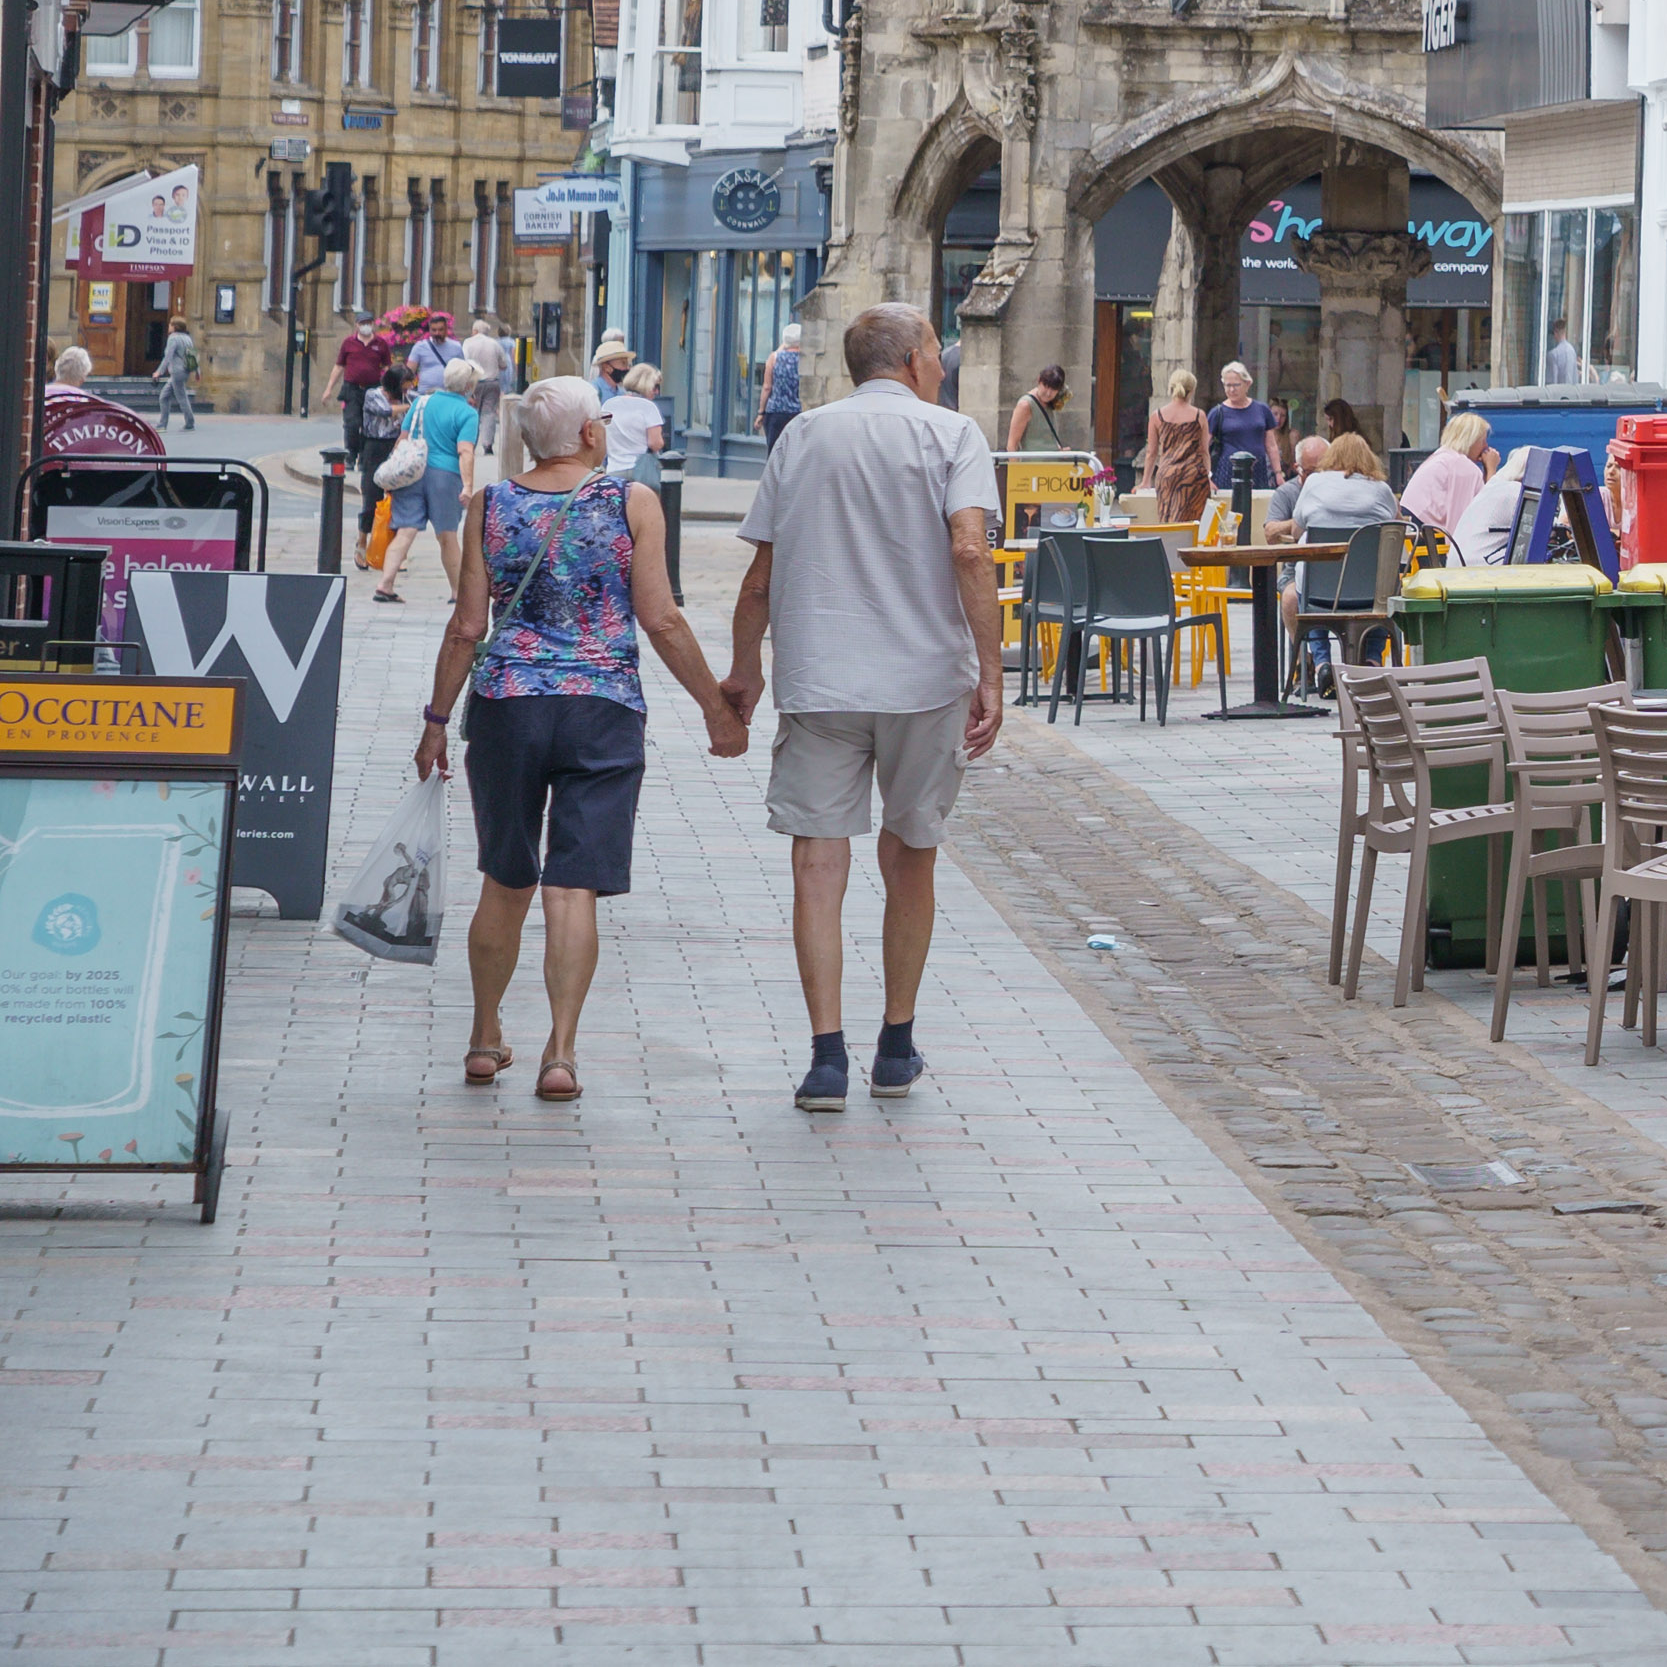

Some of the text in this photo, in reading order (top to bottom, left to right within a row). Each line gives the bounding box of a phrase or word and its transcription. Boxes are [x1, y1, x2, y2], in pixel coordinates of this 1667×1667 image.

[717, 169, 778, 197] SEASALT
[545, 189, 566, 203] JoJo
[146, 224, 190, 236] Passport
[525, 222, 560, 231] BAKERY
[149, 247, 184, 256] Photos
[129, 264, 166, 272] TIMPSON
[1241, 257, 1262, 269] the
[1433, 262, 1490, 276] company
[48, 423, 149, 456] TIMPSON
[7, 729, 161, 743] EN PROVENCE
[2, 970, 27, 980] Our
[65, 970, 82, 982] by
[24, 984, 39, 994] of
[40, 986, 63, 995] our
[65, 984, 110, 995] bottles
[113, 984, 134, 994] will
[13, 999, 127, 1009] made from 100%
[4, 1013, 112, 1025] recycled plastic
